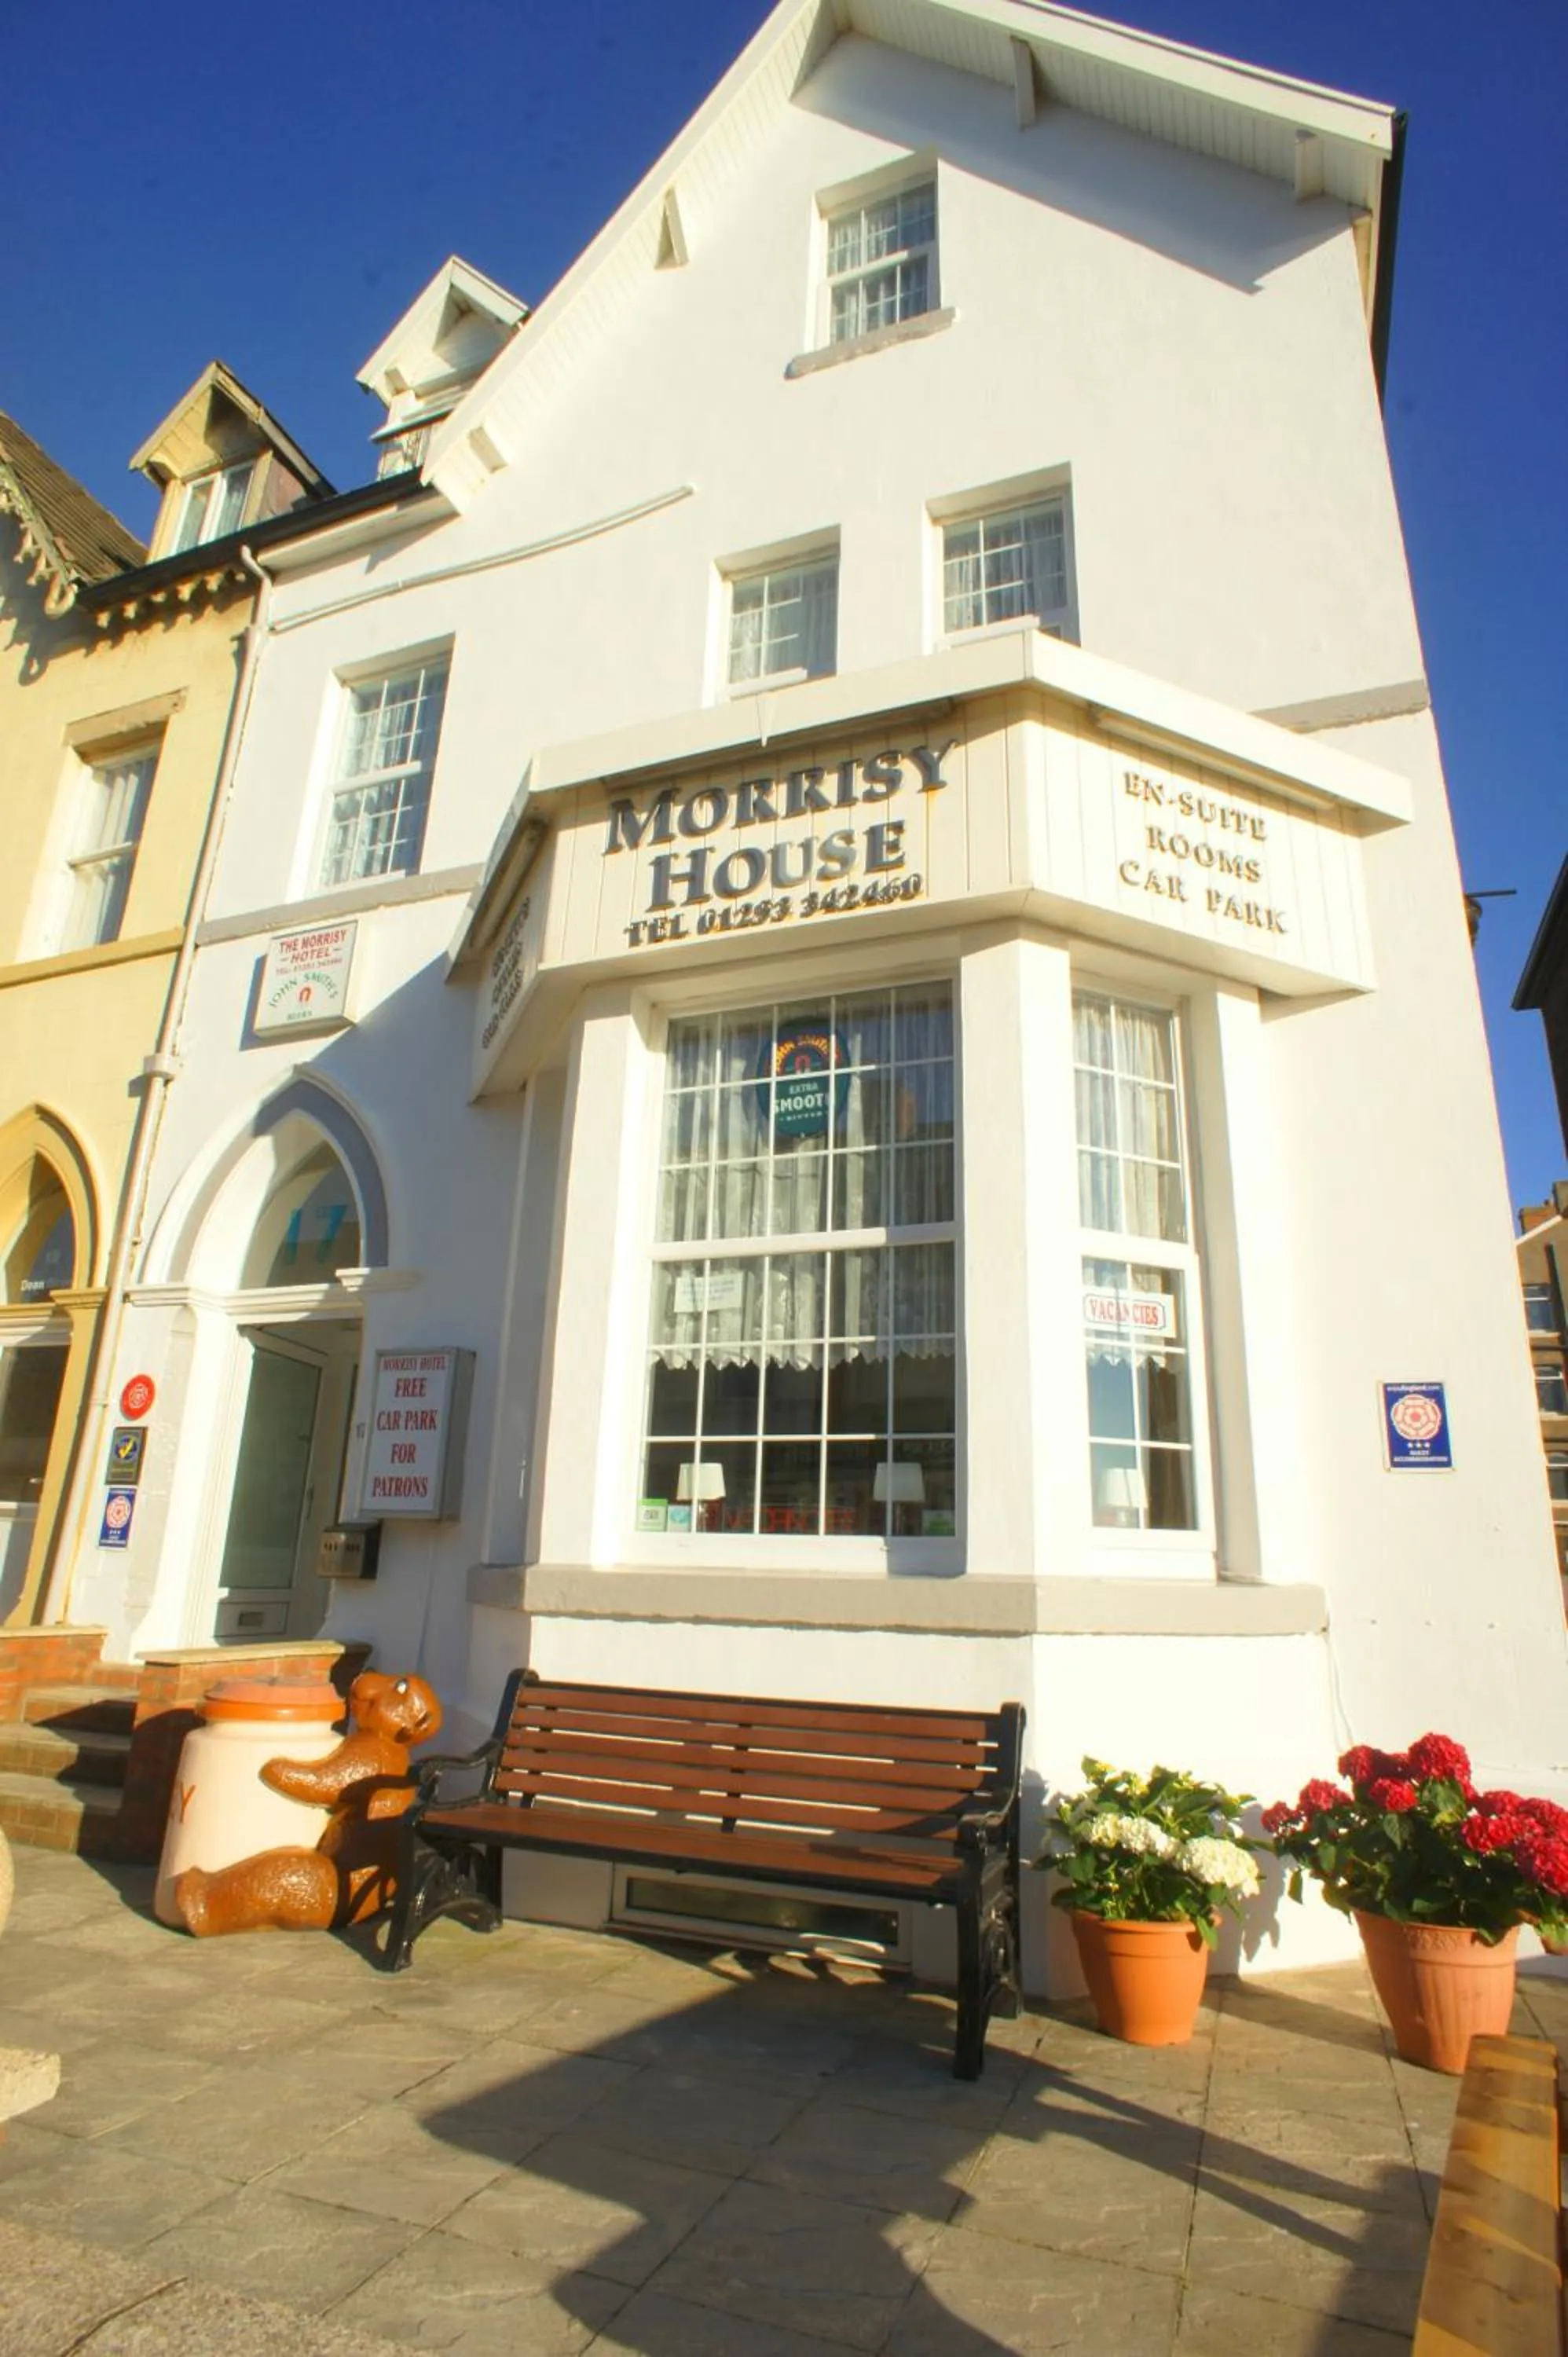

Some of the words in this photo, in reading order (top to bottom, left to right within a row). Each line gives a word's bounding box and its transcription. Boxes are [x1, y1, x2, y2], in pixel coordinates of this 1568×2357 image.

[603, 739, 960, 856] MORRISY
[1146, 824, 1262, 883] ROOMS
[647, 819, 908, 912] HOUSE
[1119, 860, 1188, 904] CAR
[1205, 888, 1288, 935] PARK
[623, 911, 691, 947] TEL
[280, 938, 299, 953] THE
[301, 929, 346, 949] MORRISY
[290, 946, 331, 964] HOTEL
[789, 1082, 818, 1094] EXTRA
[774, 1091, 828, 1113] SMOOT
[285, 1204, 346, 1264] 17
[394, 1377, 427, 1398] FREE
[376, 1410, 401, 1431] CAR
[405, 1409, 438, 1431] PARK
[390, 1443, 416, 1464] FOR
[372, 1475, 428, 1497] PATRONS
